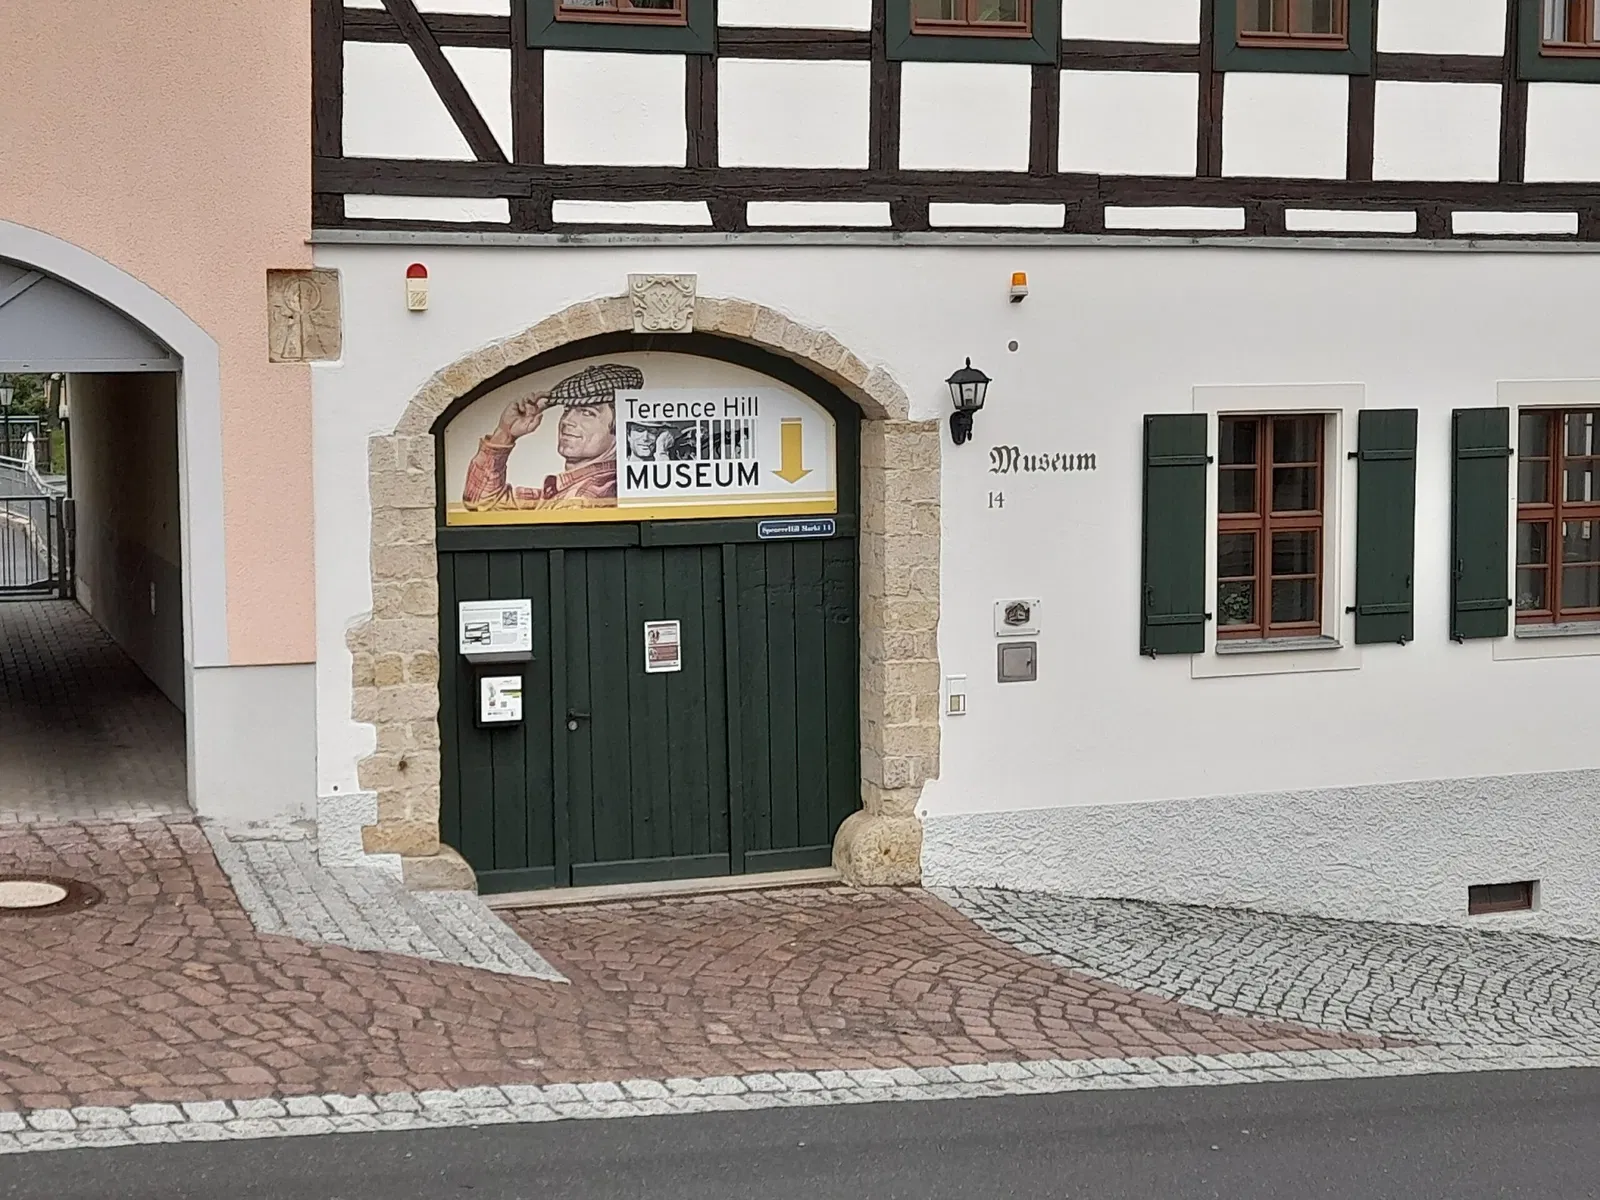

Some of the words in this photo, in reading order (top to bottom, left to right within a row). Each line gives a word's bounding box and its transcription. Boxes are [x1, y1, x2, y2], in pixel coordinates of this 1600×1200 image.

[625, 398, 716, 419] Terence
[724, 396, 758, 417] Hill
[988, 445, 1096, 474] Museum
[626, 461, 759, 490] MUSEUM
[988, 491, 1005, 508] 14
